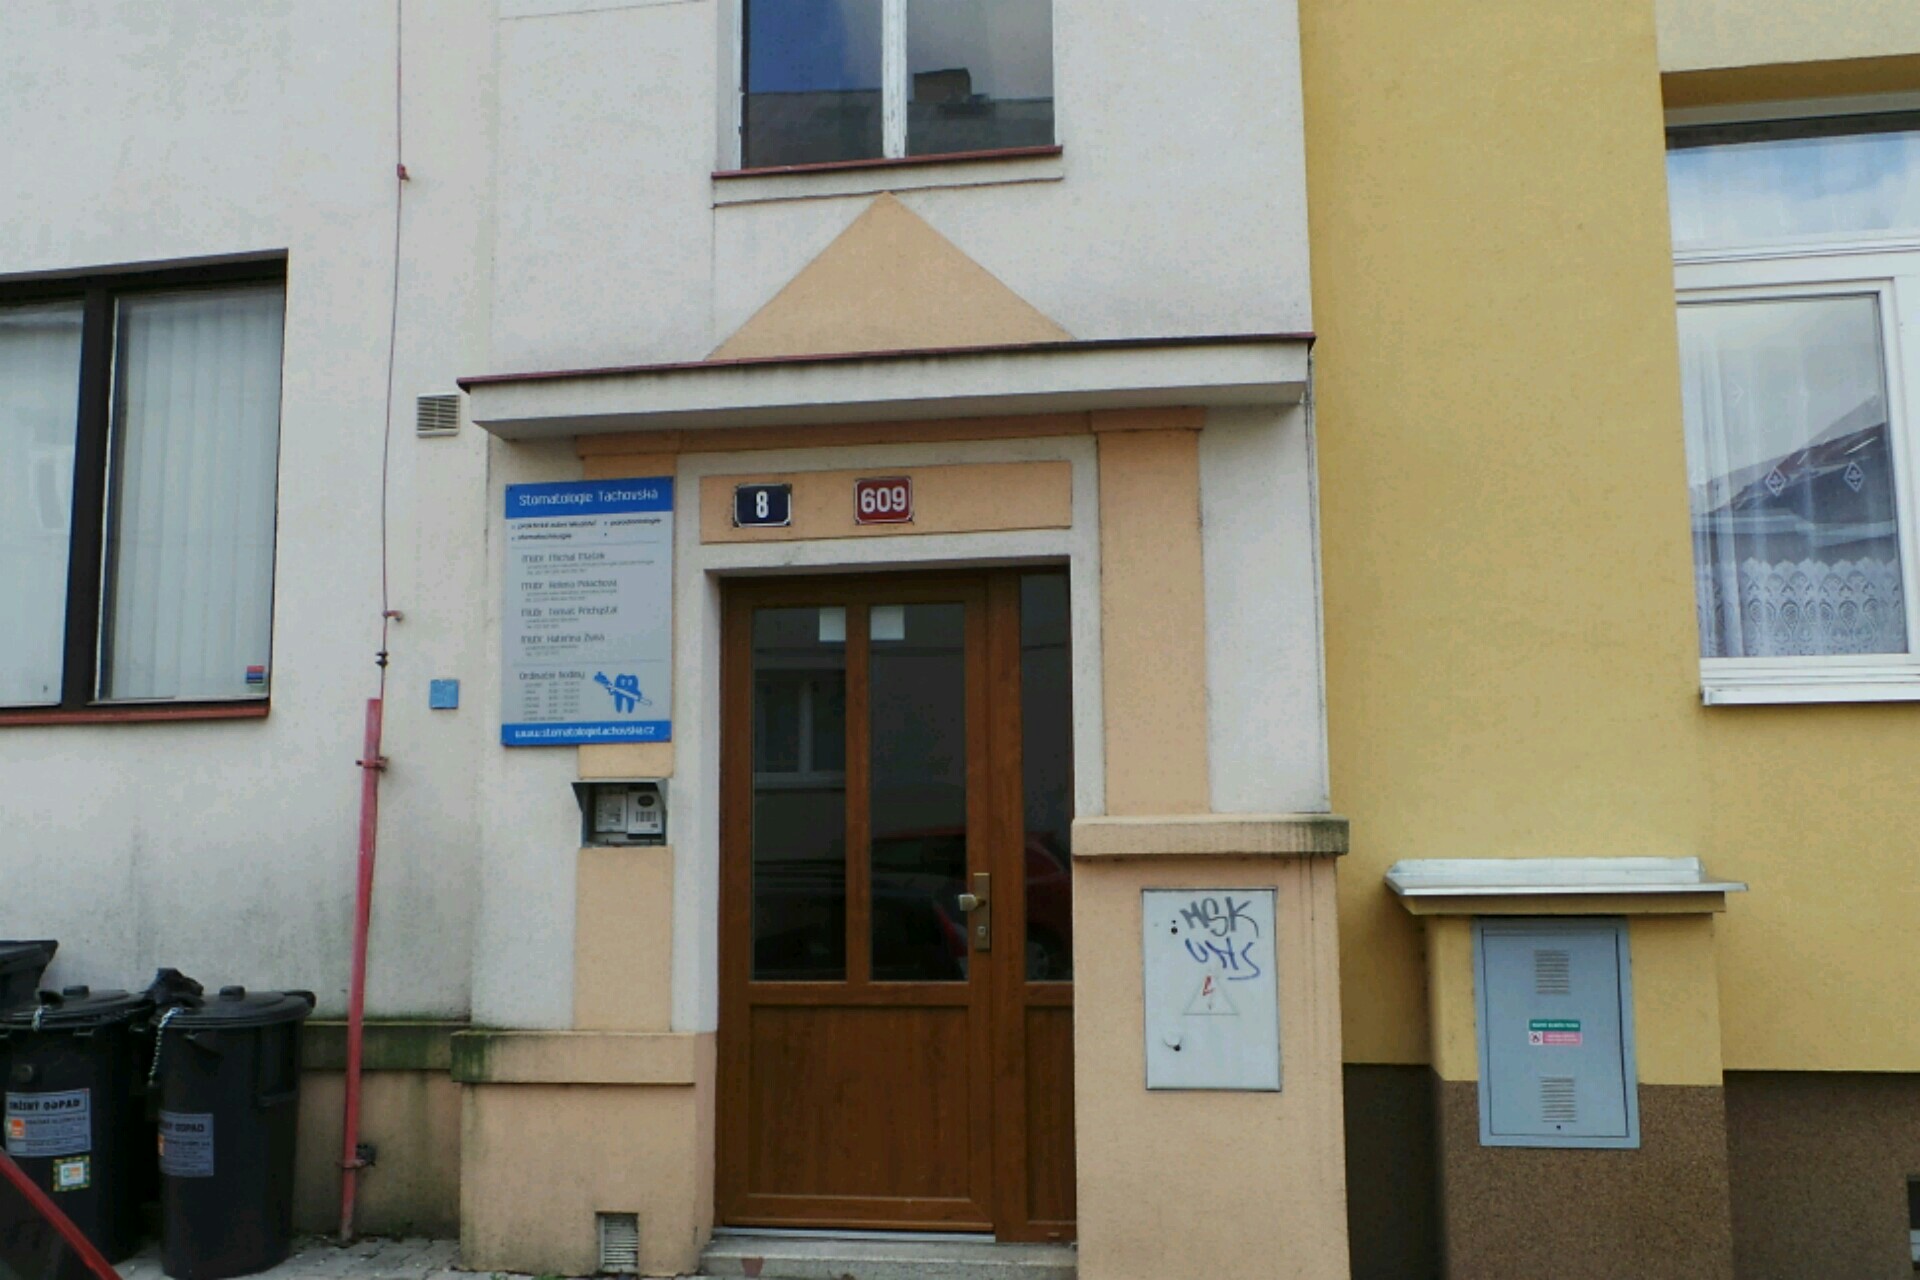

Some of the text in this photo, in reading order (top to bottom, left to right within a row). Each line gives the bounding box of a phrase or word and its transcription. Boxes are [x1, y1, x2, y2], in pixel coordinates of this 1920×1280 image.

[518, 492, 593, 507] Stomatologie
[755, 490, 769, 519] 8
[860, 485, 907, 514] 609
